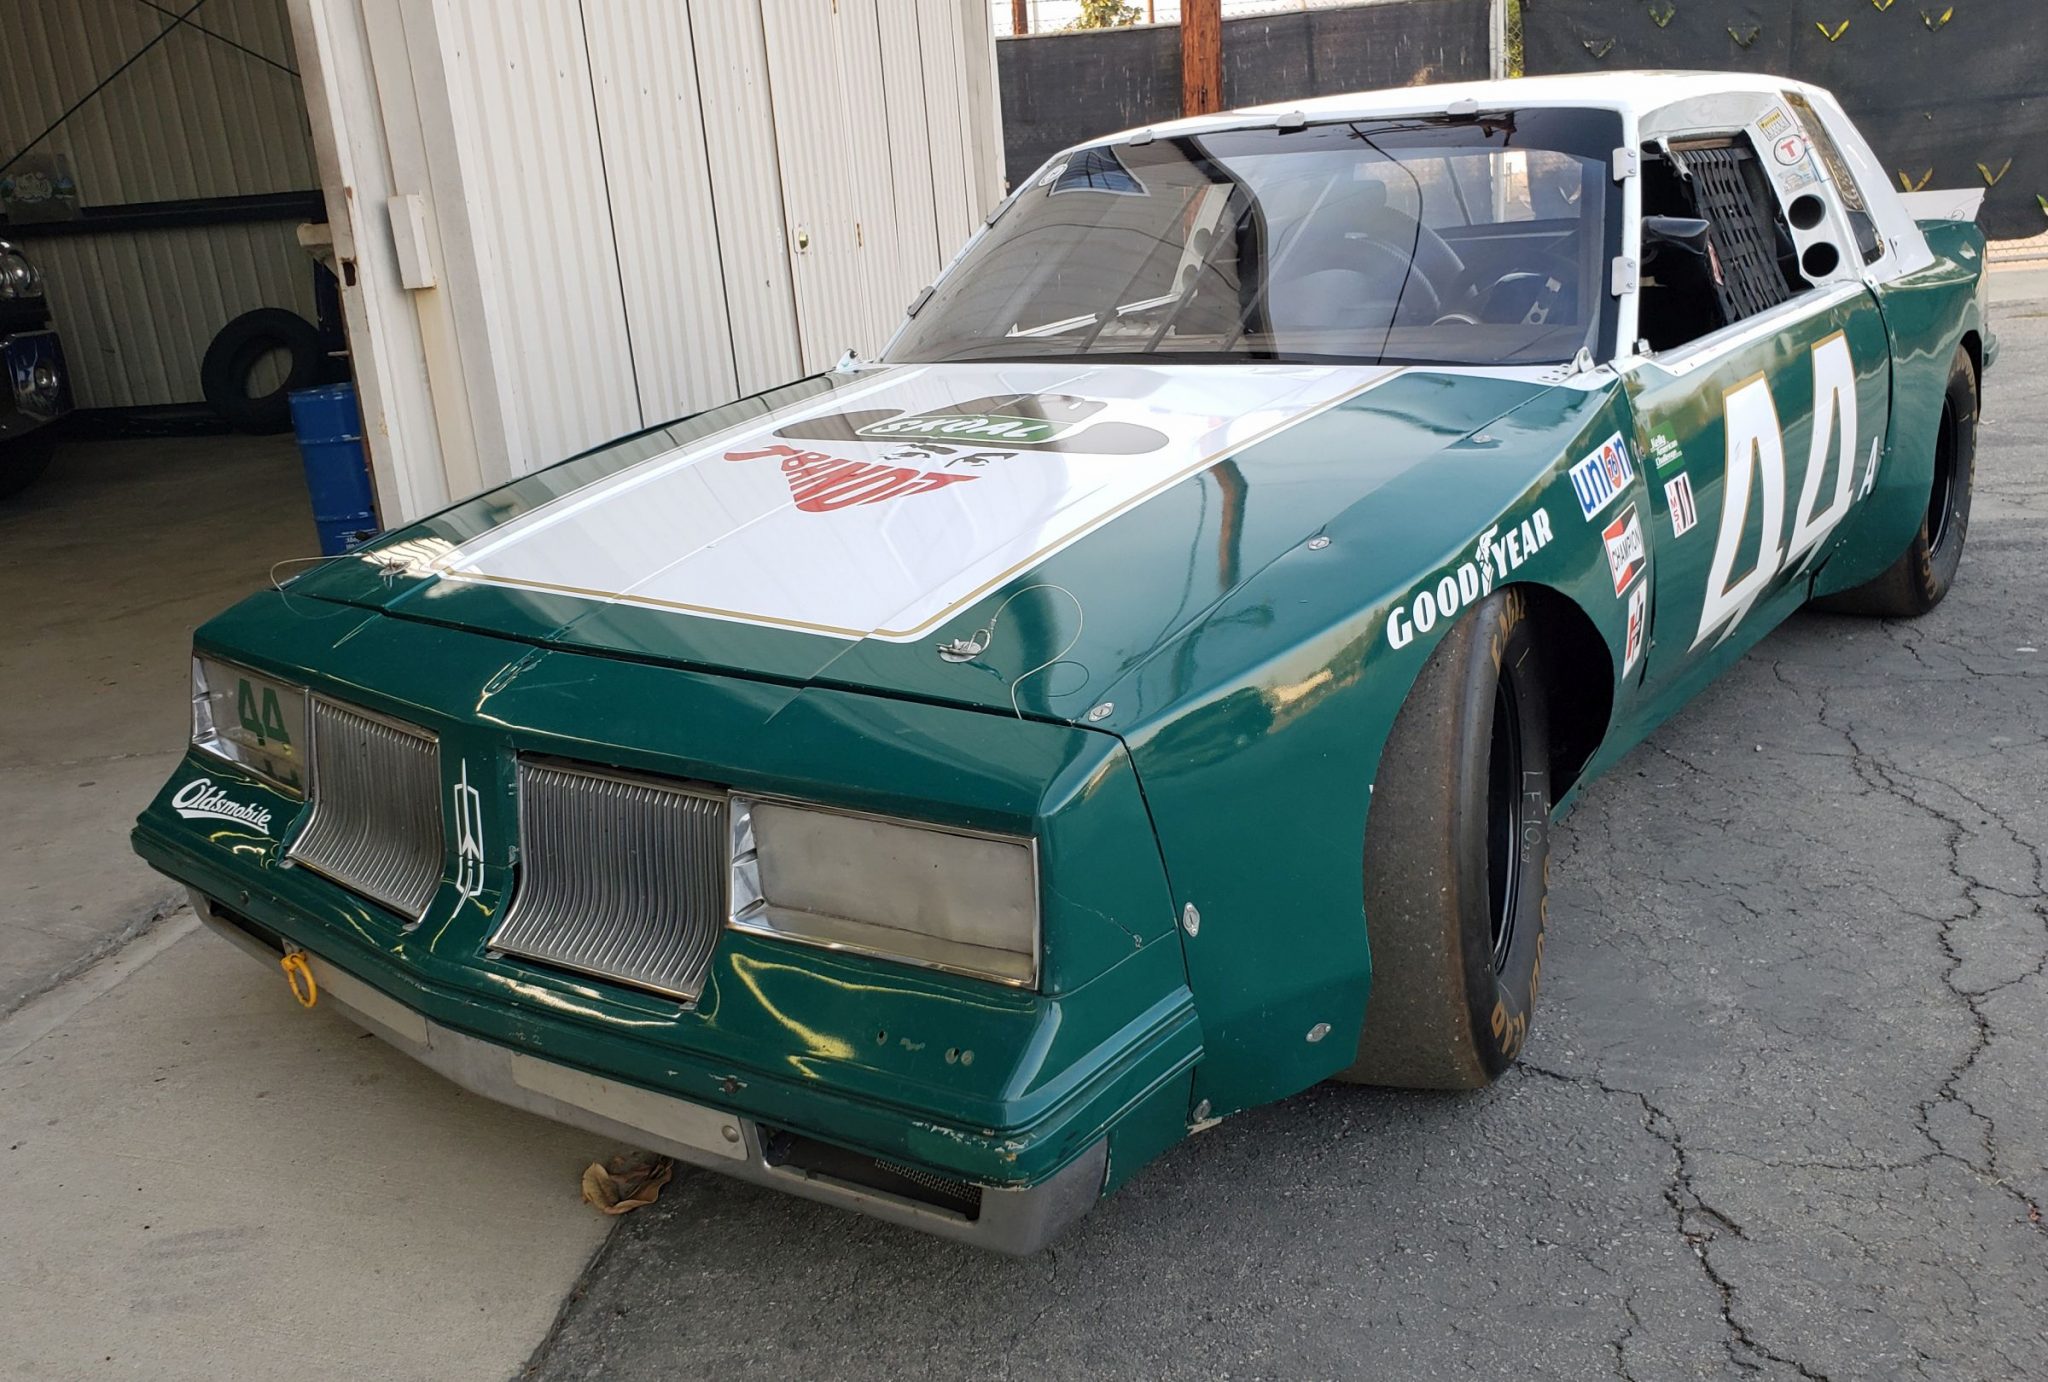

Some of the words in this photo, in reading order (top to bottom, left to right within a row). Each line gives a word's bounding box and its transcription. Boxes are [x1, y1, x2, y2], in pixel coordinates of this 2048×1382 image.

[871, 418, 1049, 438] SKOAL
[1668, 484, 1683, 535] IMSA
[1612, 526, 1642, 572] CHAMPION
[238, 678, 290, 747] 44
[171, 777, 272, 829] Oldsmobile
